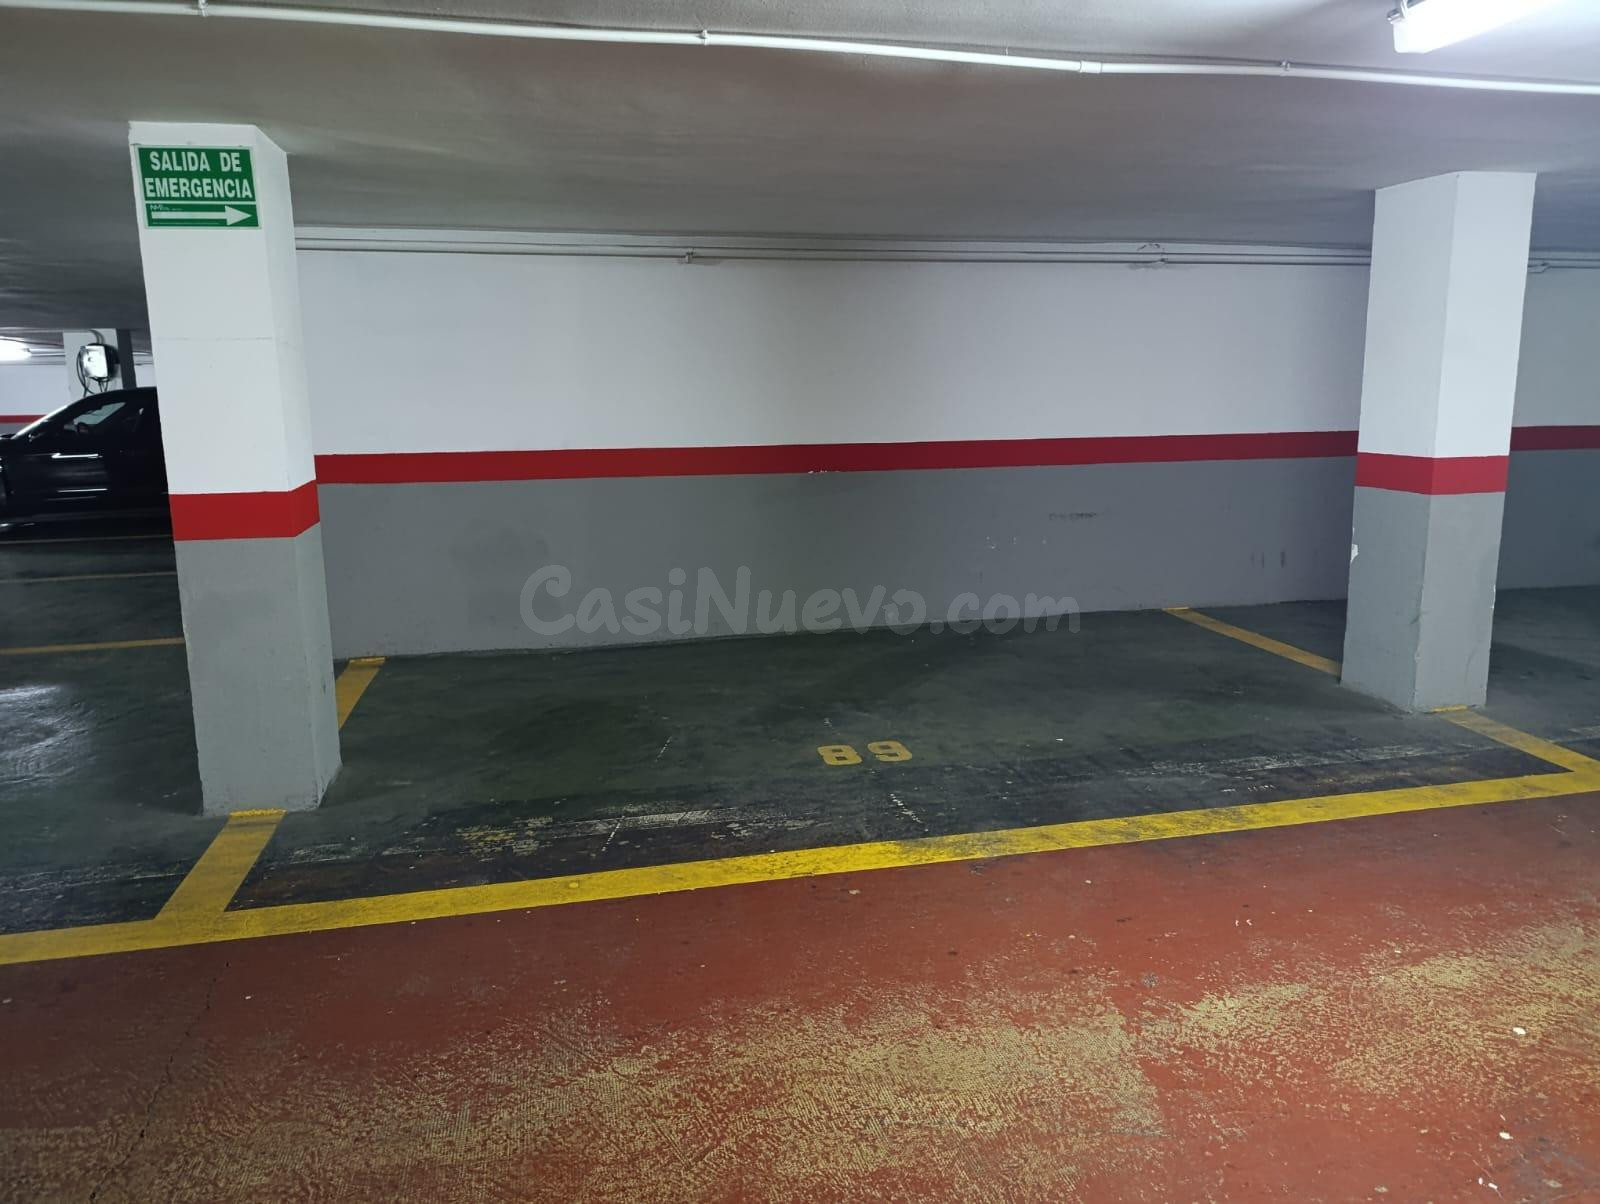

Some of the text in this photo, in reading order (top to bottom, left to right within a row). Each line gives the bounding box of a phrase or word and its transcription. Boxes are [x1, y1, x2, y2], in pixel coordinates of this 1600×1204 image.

[149, 151, 242, 172] SALIDA DE
[144, 177, 253, 198] EMERGENCIA
[817, 740, 913, 766] 89
